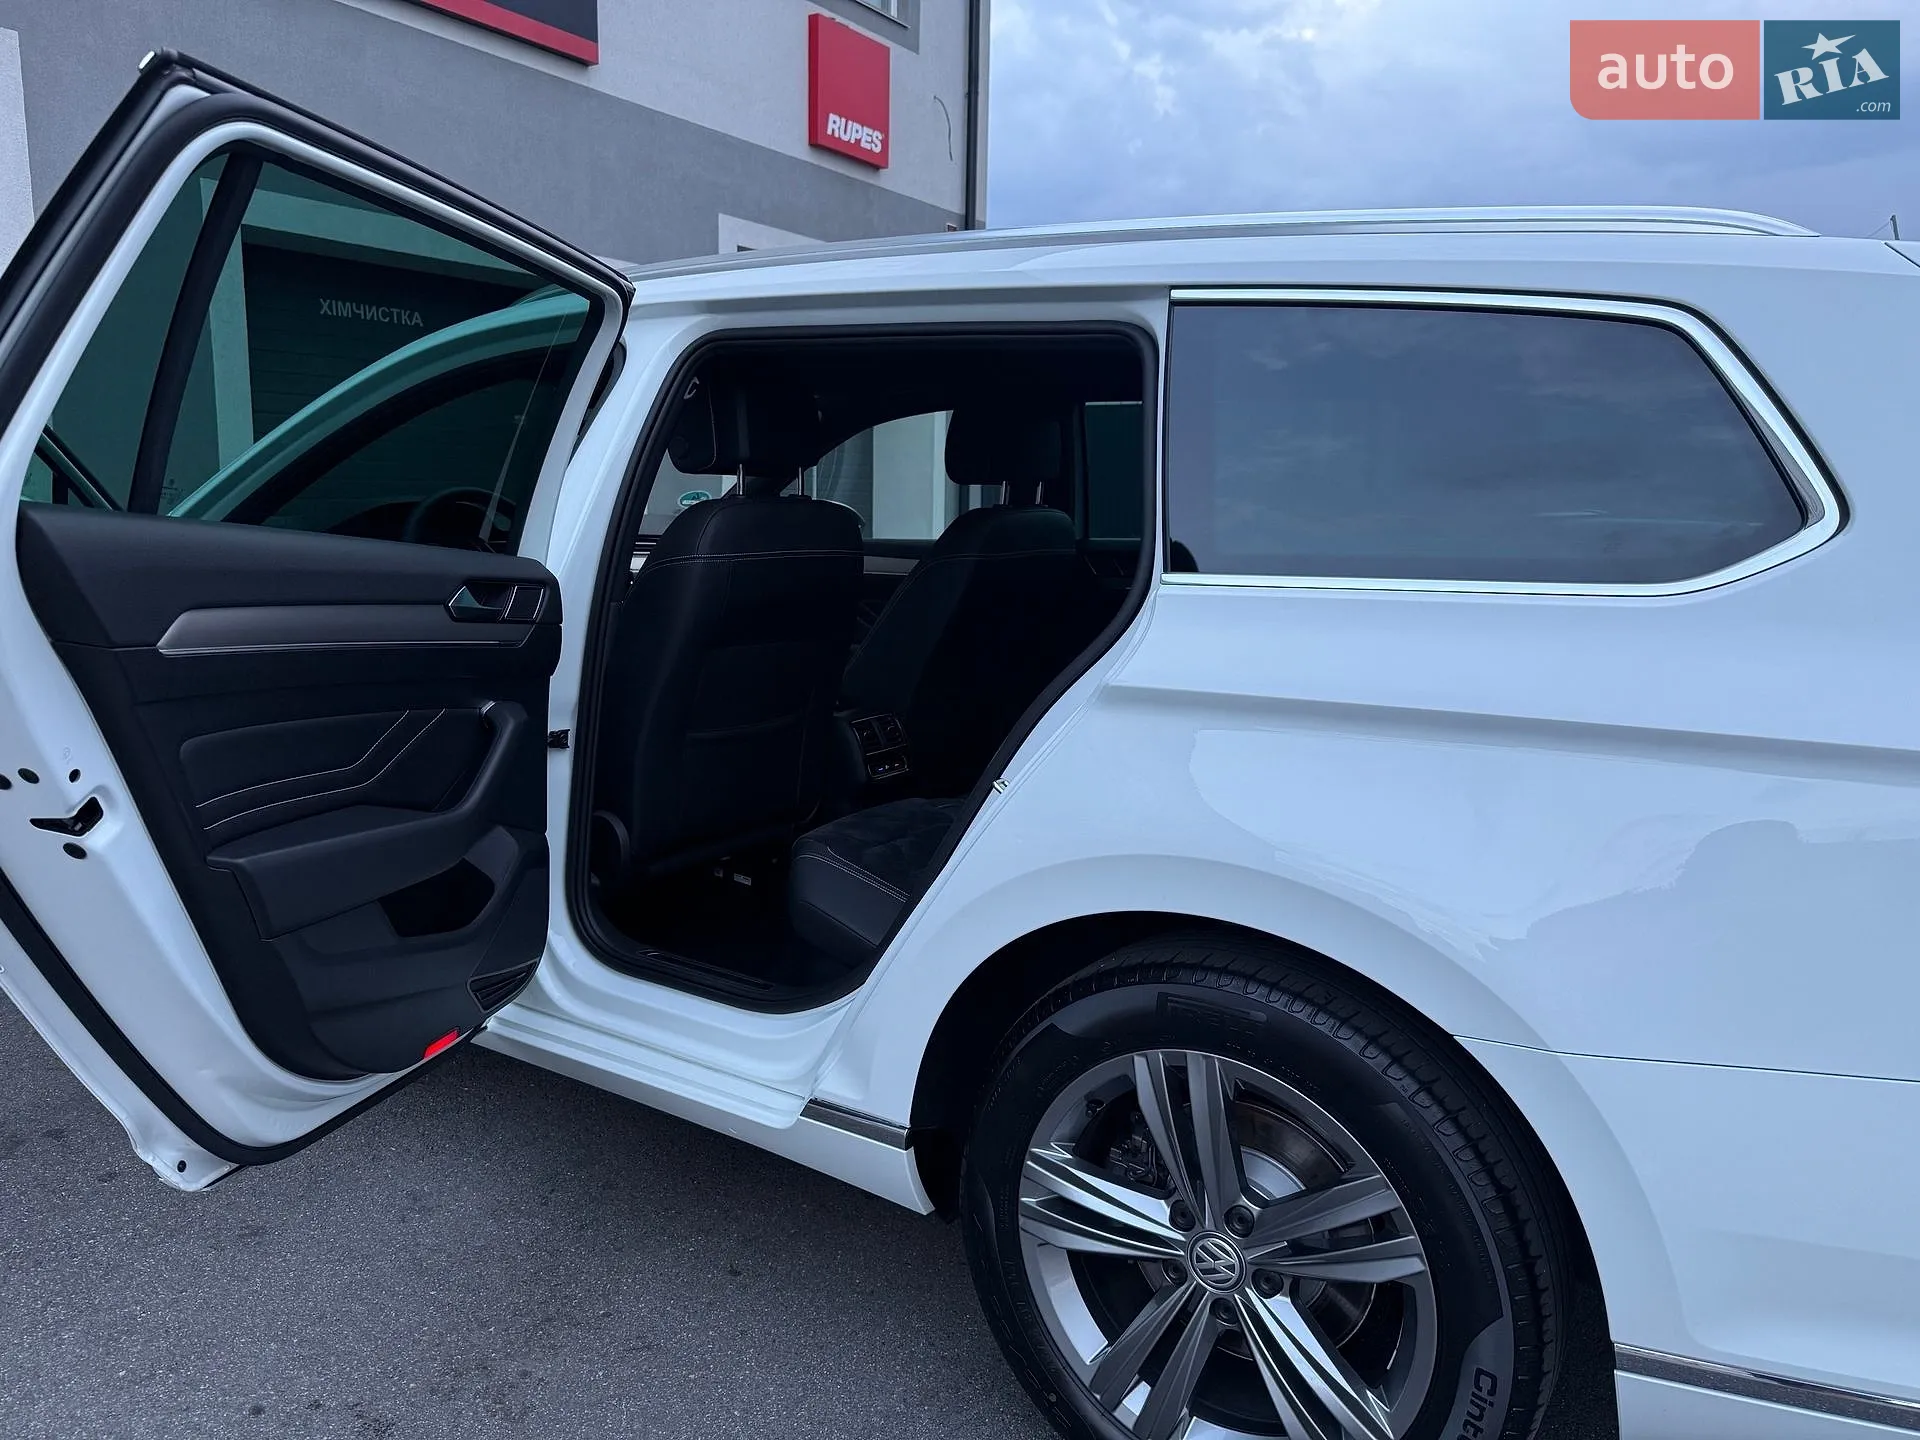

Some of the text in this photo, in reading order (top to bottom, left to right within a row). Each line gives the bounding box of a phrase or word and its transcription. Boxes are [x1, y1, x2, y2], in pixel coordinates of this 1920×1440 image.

[826, 112, 883, 153] RUPES
[319, 298, 424, 327] ХІМЧИСТКА
[1456, 1367, 1498, 1440] Cint
